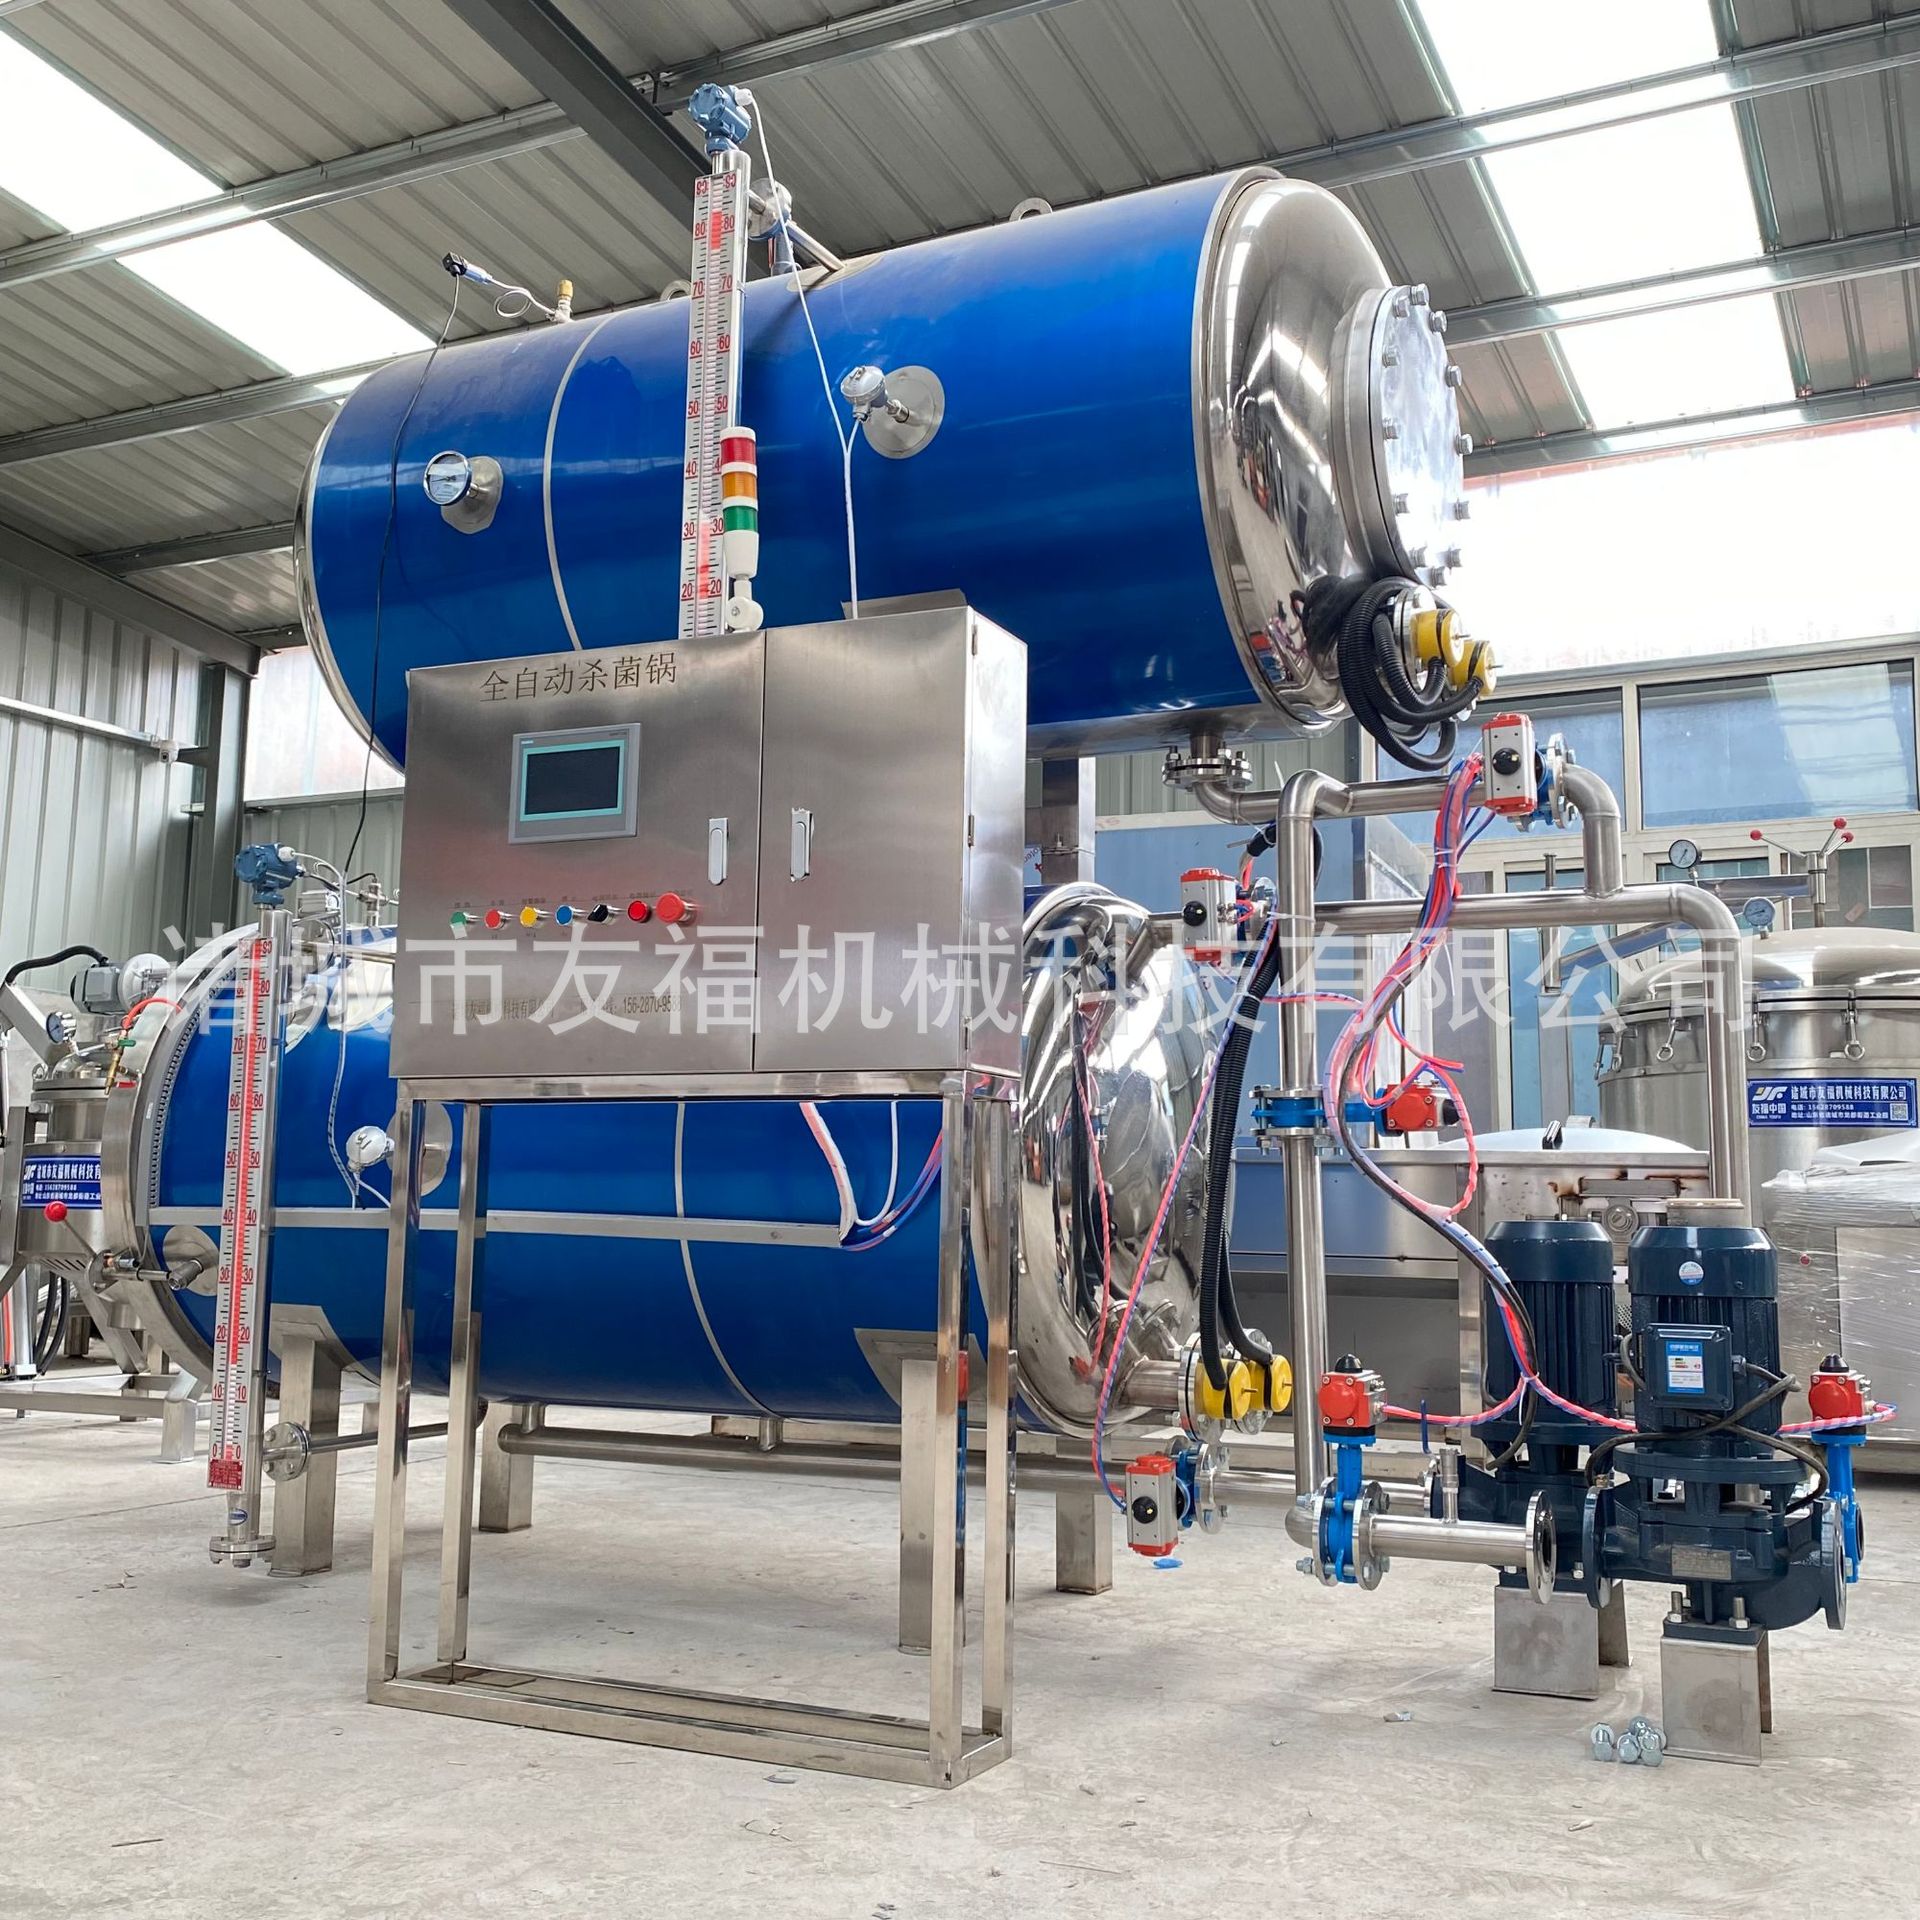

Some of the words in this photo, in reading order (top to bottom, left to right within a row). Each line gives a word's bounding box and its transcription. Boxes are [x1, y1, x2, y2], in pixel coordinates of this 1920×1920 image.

[695, 222, 705, 237] 80
[724, 215, 735, 230] 80
[693, 281, 703, 296] 70
[721, 275, 732, 290] 70
[690, 340, 701, 355] 60
[719, 335, 730, 350] 60
[688, 401, 699, 416] 50
[717, 395, 728, 410] 50
[686, 461, 697, 475] 40
[684, 522, 695, 536] 30
[712, 518, 724, 533] 30
[682, 583, 693, 598] 20
[710, 579, 722, 594] 20
[480, 652, 677, 702] 全自动杀菌锅
[261, 980, 270, 993] 80
[234, 1037, 244, 1051] 70
[257, 1037, 267, 1051] 70
[230, 1093, 240, 1108] 60
[253, 1093, 264, 1108] 60
[227, 1151, 236, 1165] 50
[250, 1151, 260, 1165] 50
[223, 1208, 233, 1223] 40
[246, 1209, 257, 1223] 40
[219, 1267, 229, 1281] 30
[243, 1267, 254, 1282] 30
[216, 1325, 226, 1339] 20
[240, 1326, 250, 1340] 20
[213, 1384, 223, 1398] 10
[237, 1385, 247, 1399] 10
[213, 1443, 218, 1457] 0
[235, 1445, 241, 1459] 0
